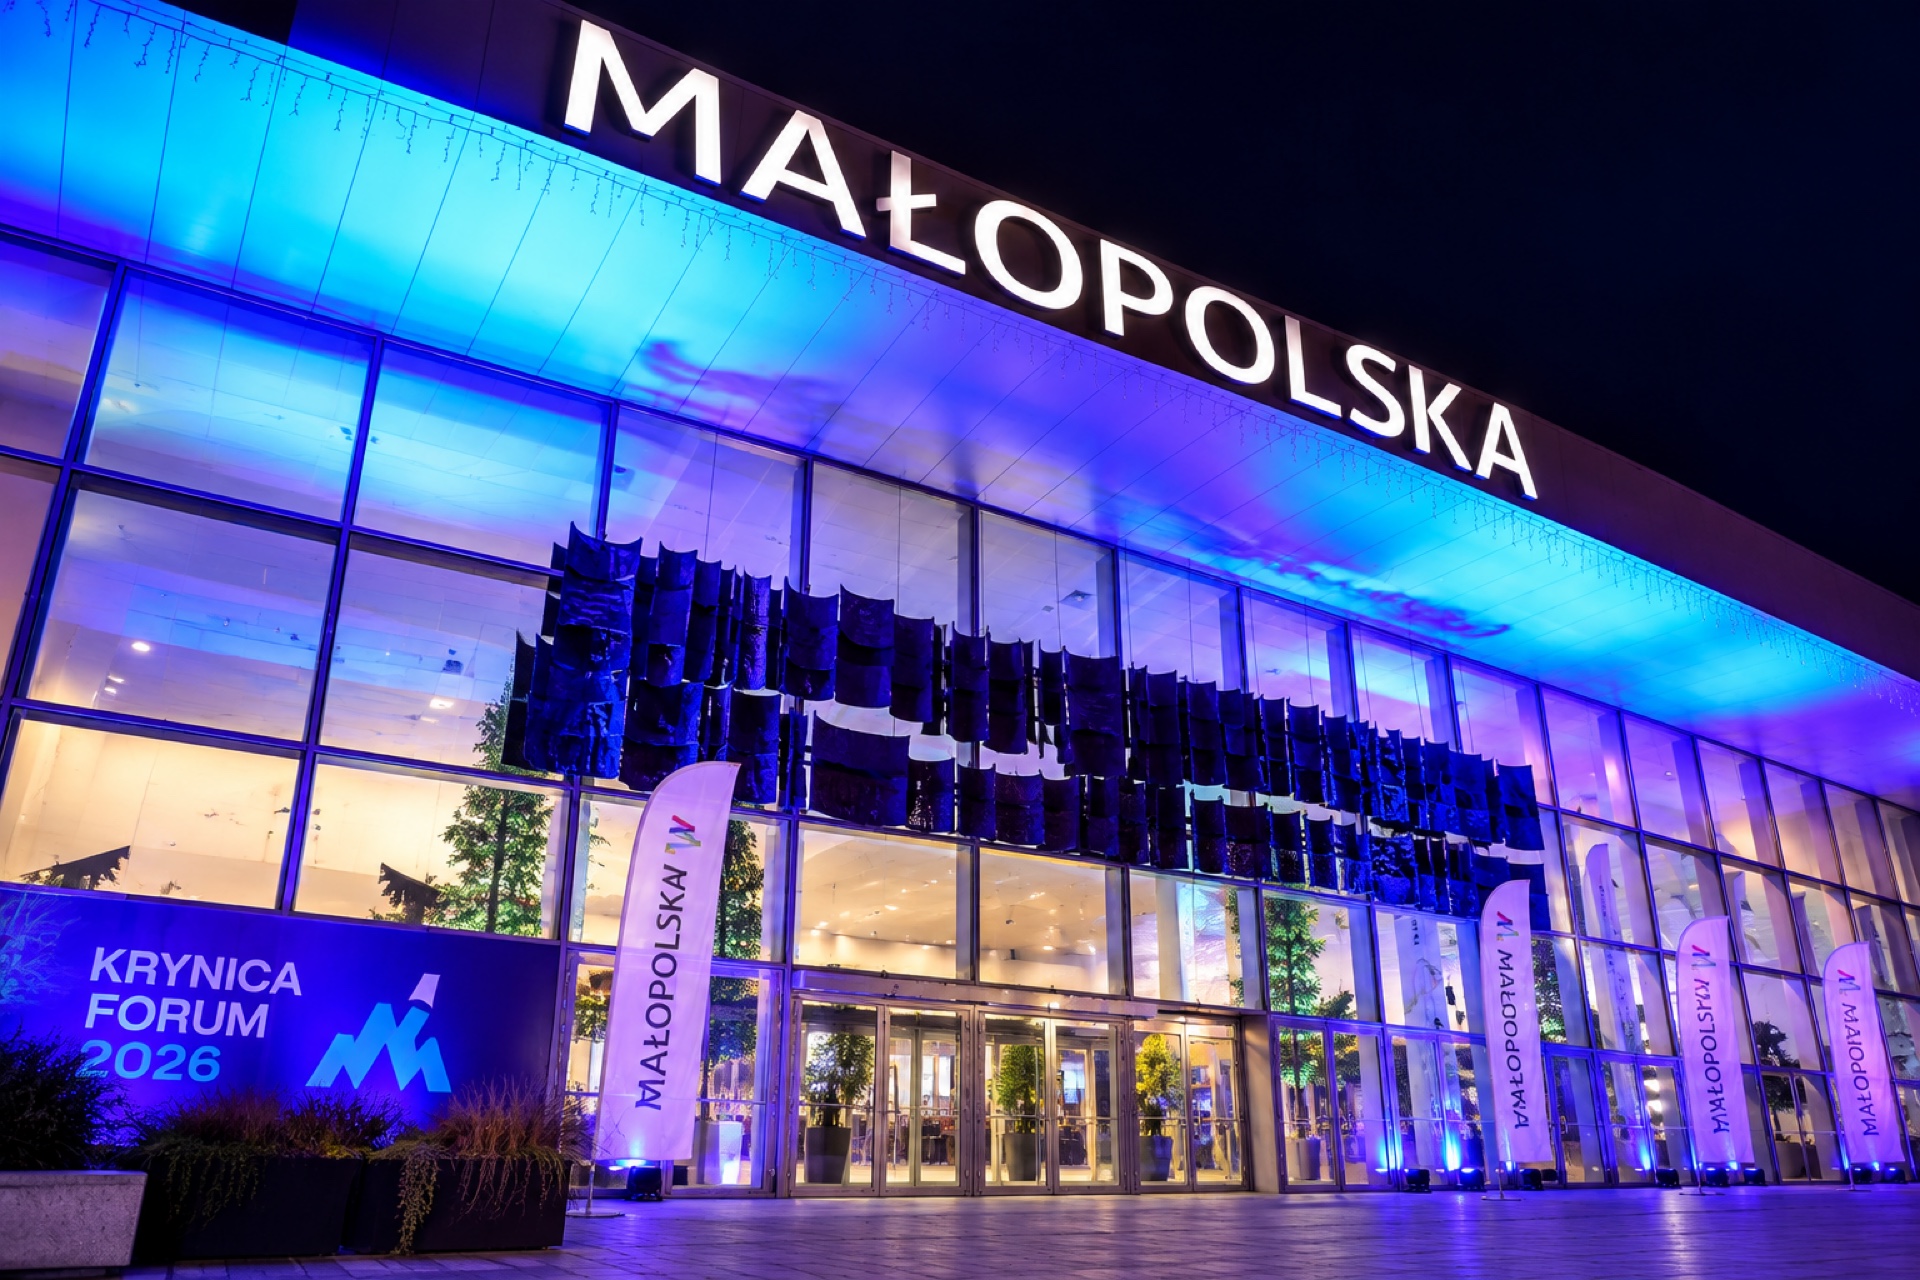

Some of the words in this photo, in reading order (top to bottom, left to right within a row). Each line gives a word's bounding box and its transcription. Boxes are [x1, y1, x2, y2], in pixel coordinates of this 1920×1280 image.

[563, 19, 1540, 500] MAŁOPOLSKA
[89, 946, 302, 996] KRYNICA
[84, 993, 270, 1039] FORUM
[74, 1039, 221, 1082] 2026
